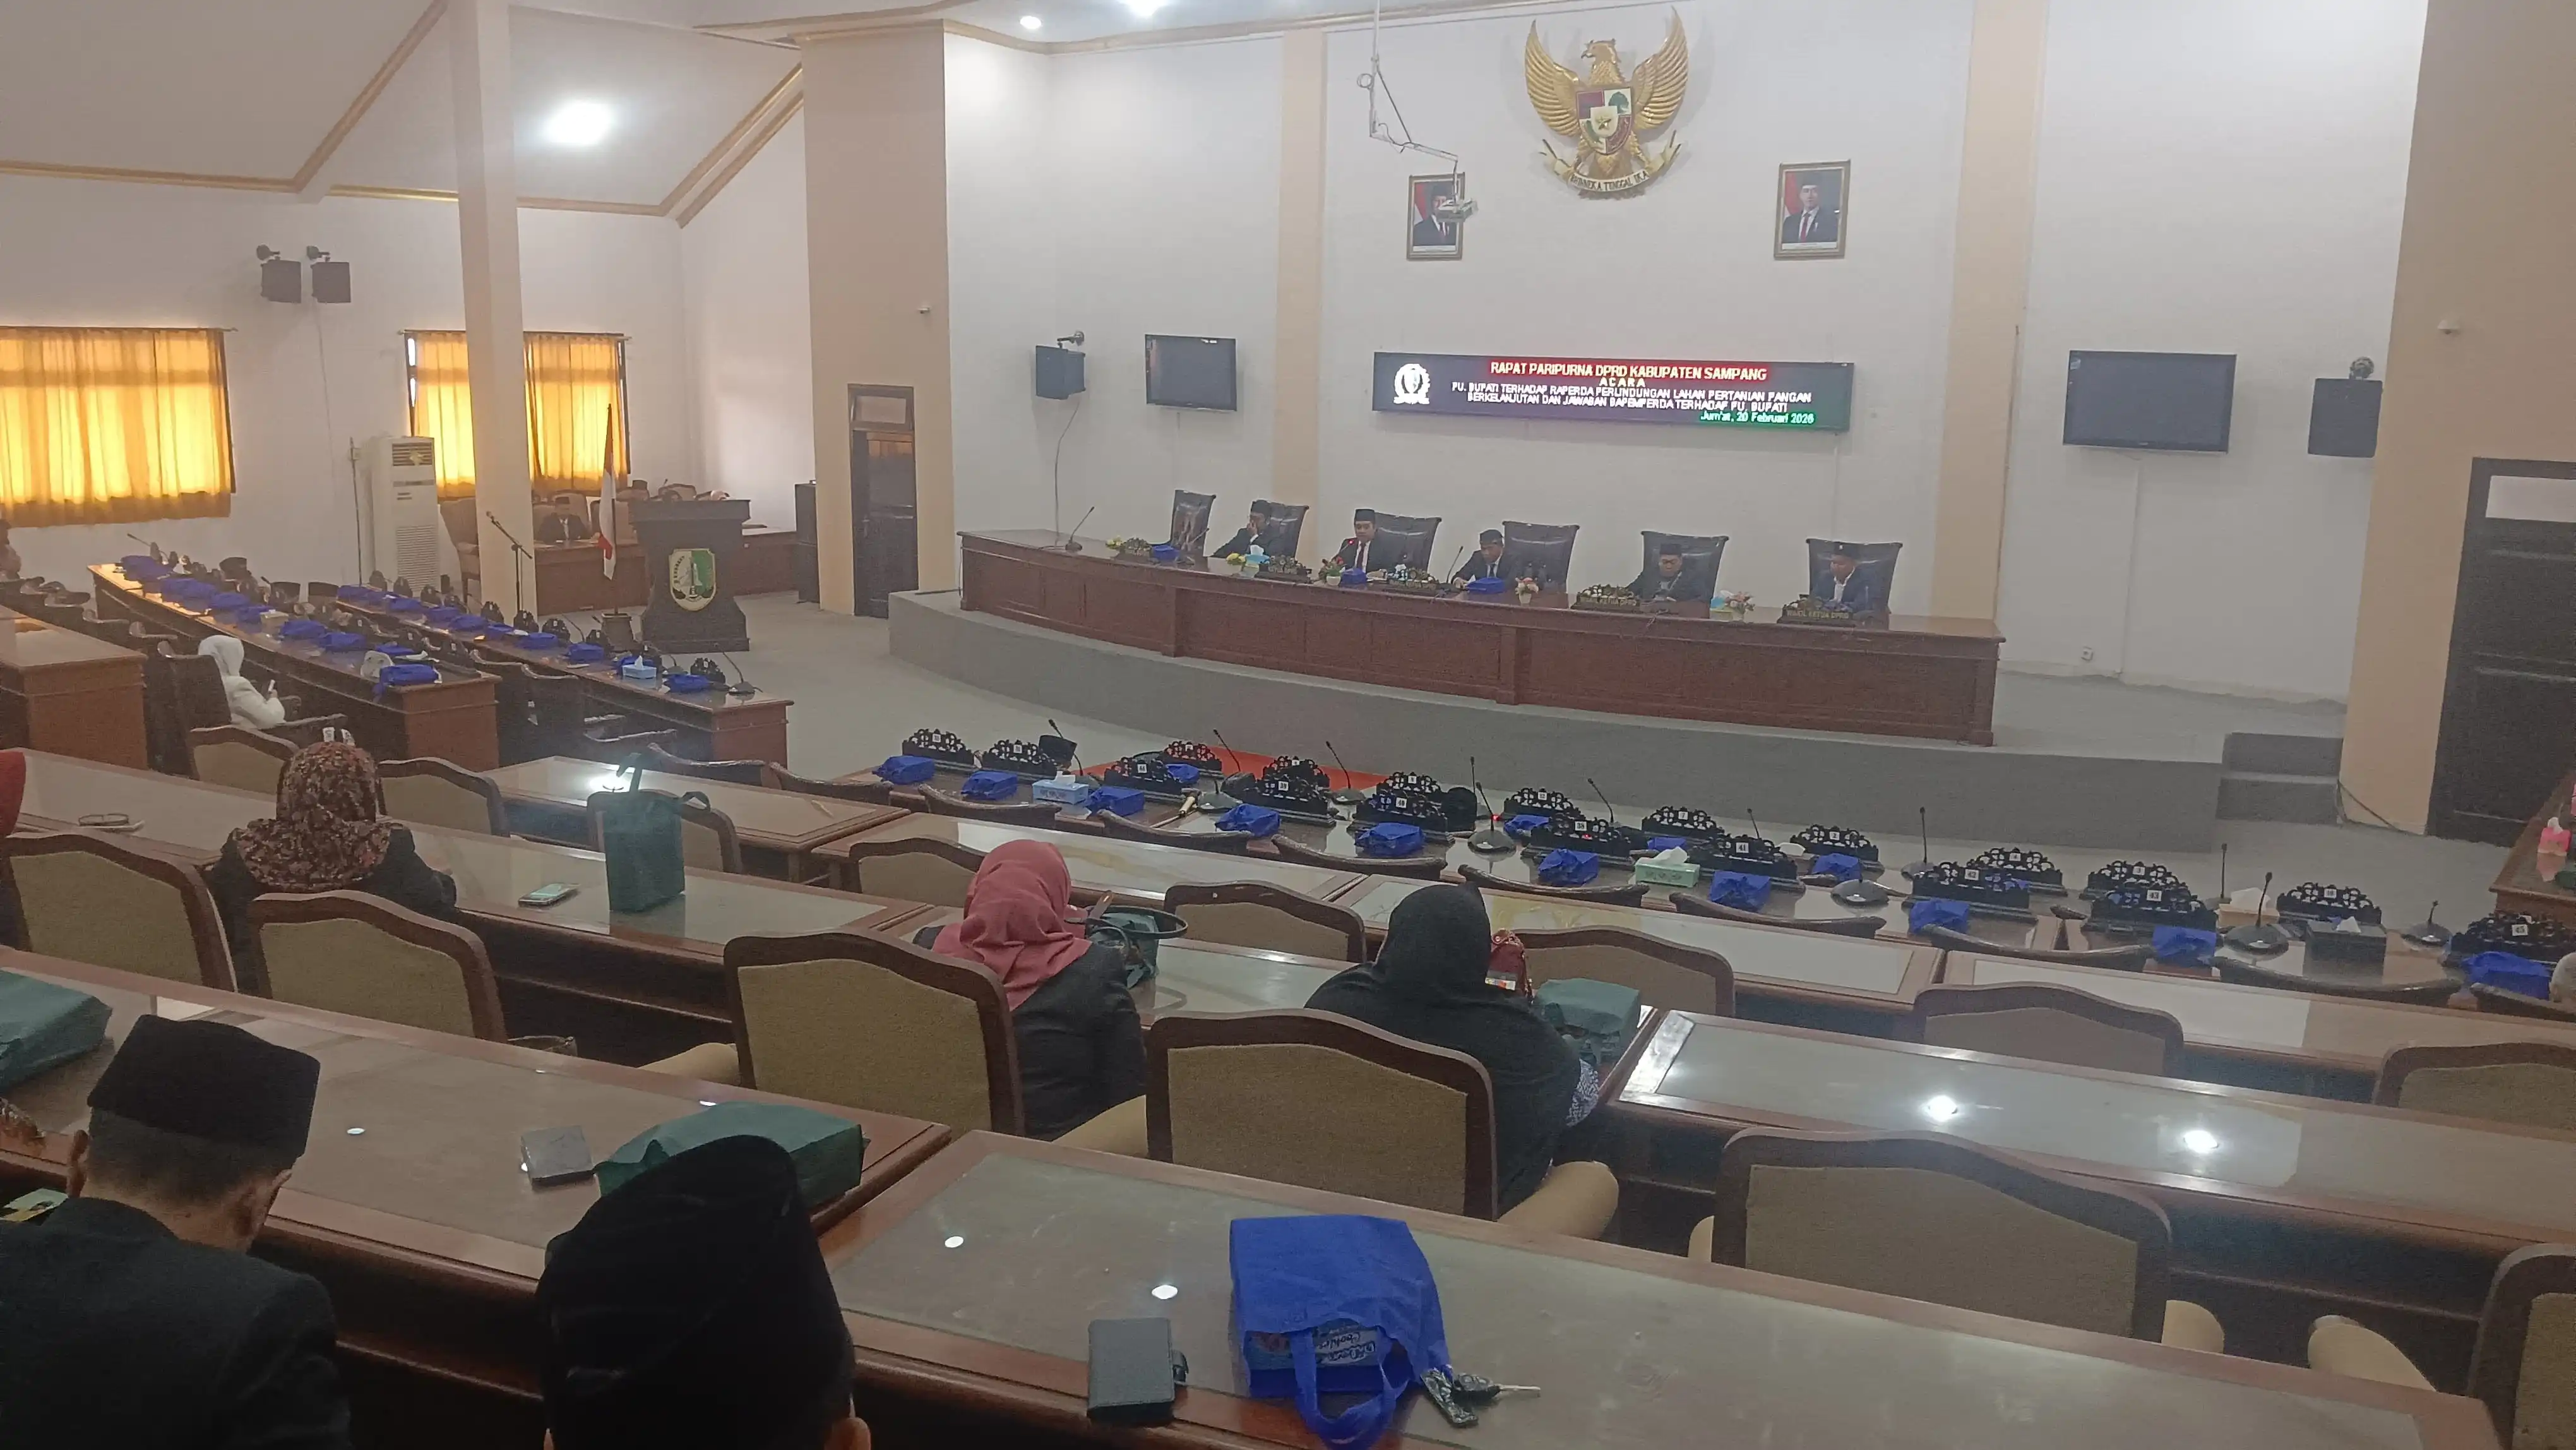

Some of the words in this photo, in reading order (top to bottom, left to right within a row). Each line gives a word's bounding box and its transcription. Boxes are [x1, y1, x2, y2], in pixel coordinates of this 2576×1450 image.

[1634, 171, 1649, 183] IKA
[1491, 362, 1527, 374] RAPAT
[1529, 363, 1593, 376] PARIPURNA
[1595, 365, 1627, 377] DPRD
[1630, 366, 1702, 379] KABUPATEN
[1704, 367, 1767, 380] SAMPANG
[1599, 377, 1645, 387] ACARA
[1452, 381, 1466, 392] PU.
[1469, 382, 1499, 393] BUPATI
[1501, 383, 1547, 395] TERHADAP
[1550, 385, 1594, 397] RAPERDA
[1673, 388, 1705, 399] LAHAN
[1708, 390, 1765, 401] PERTANIAN
[1768, 392, 1811, 403] PANGAN
[1467, 392, 1539, 404] BERKELANJUTAN
[1542, 395, 1561, 405] DAN
[1563, 395, 1607, 407] JAWABAN
[1674, 399, 1727, 410] TERHADAP
[1751, 402, 1787, 412] BUPATI
[1736, 412, 1748, 422] 20
[1751, 412, 1789, 423] Februari
[1791, 414, 1815, 424] 2026
